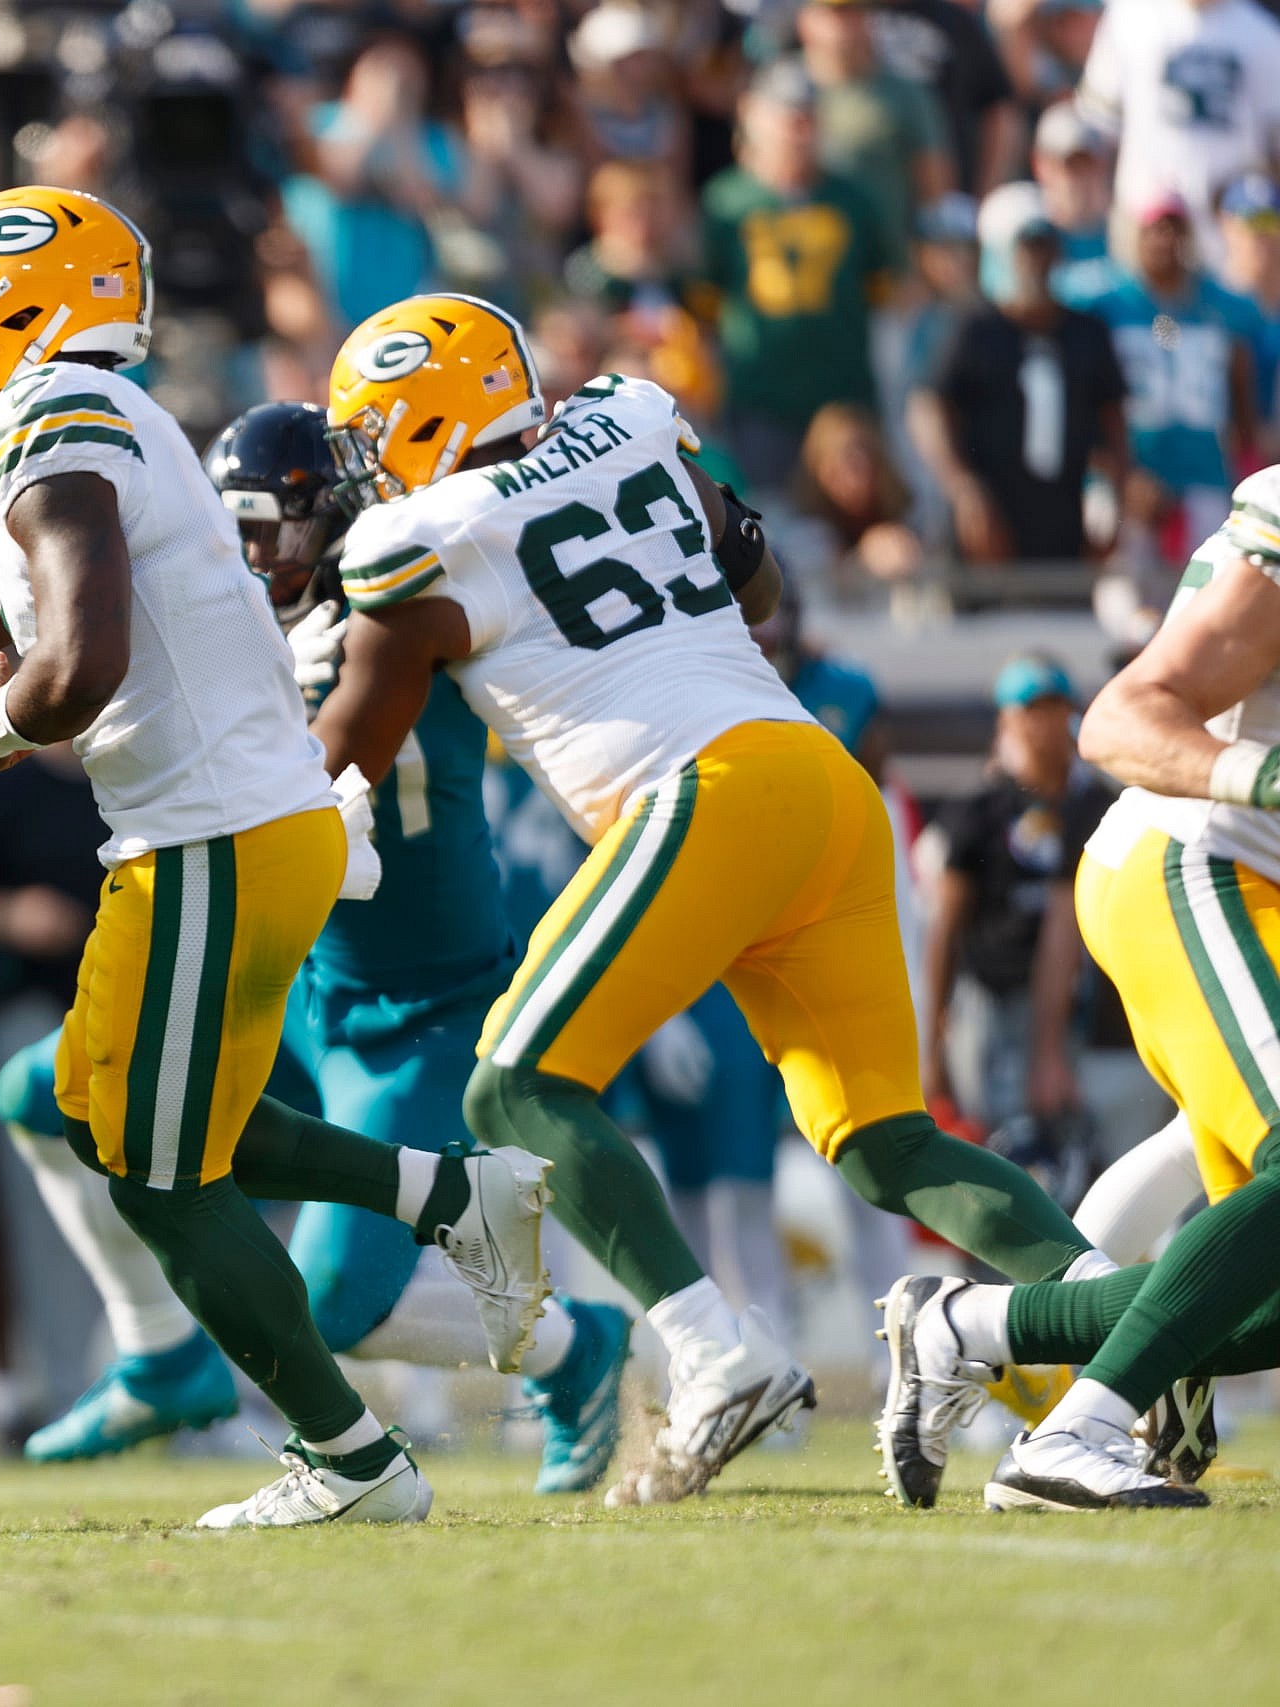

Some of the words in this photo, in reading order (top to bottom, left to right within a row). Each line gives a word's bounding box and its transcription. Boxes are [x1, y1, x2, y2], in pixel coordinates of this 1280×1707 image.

[357, 331, 432, 382] G
[480, 412, 633, 499] WALKER
[515, 460, 734, 652] 63
